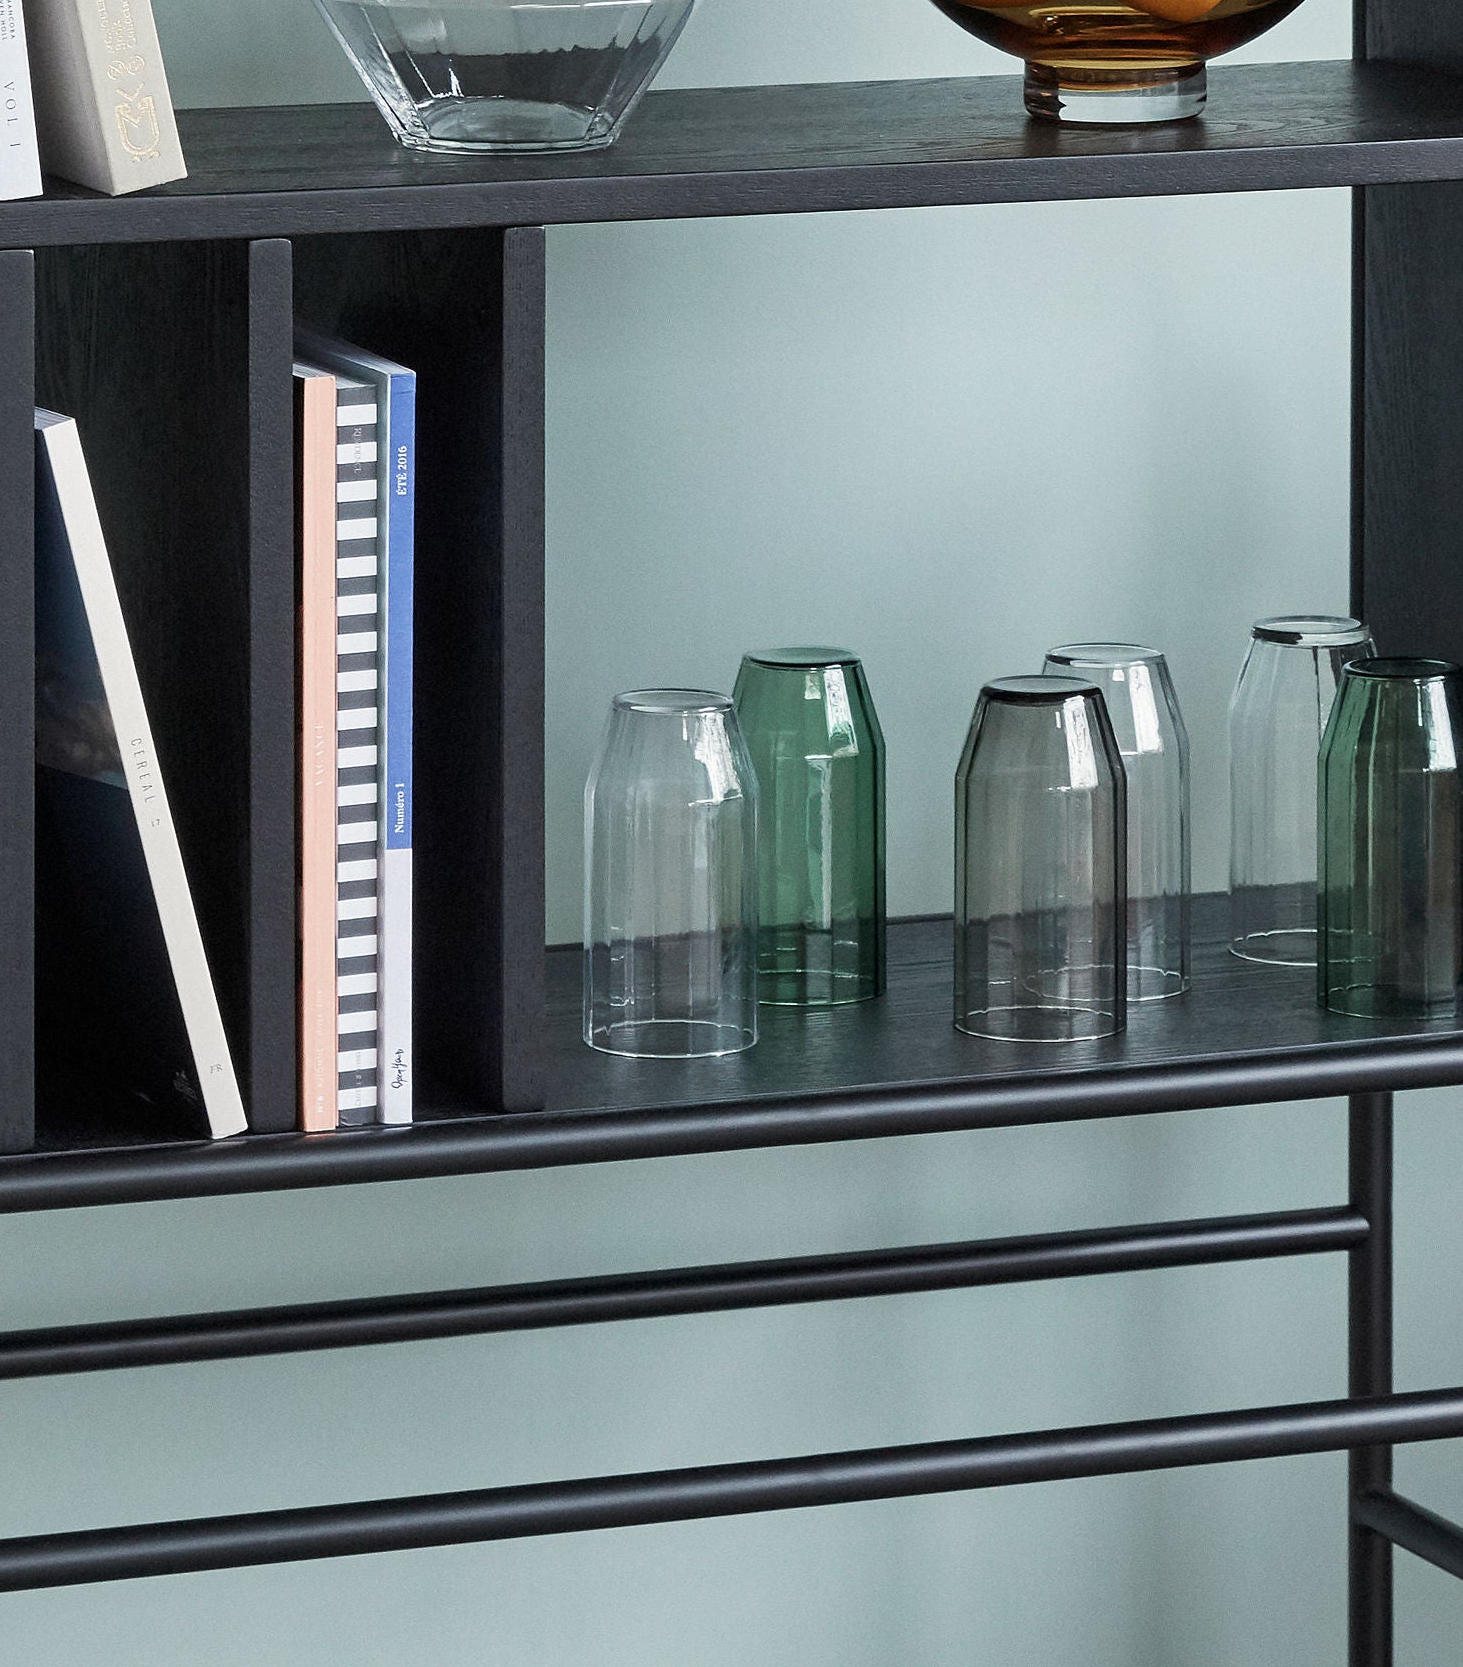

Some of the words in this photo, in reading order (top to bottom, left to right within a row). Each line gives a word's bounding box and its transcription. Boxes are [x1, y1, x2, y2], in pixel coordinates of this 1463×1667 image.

[3, 82, 18, 126] VOL
[398, 446, 408, 470] 2016
[396, 473, 407, 495] ÉTÉ
[131, 738, 155, 803] CEREAL
[394, 791, 405, 833] Numéro
